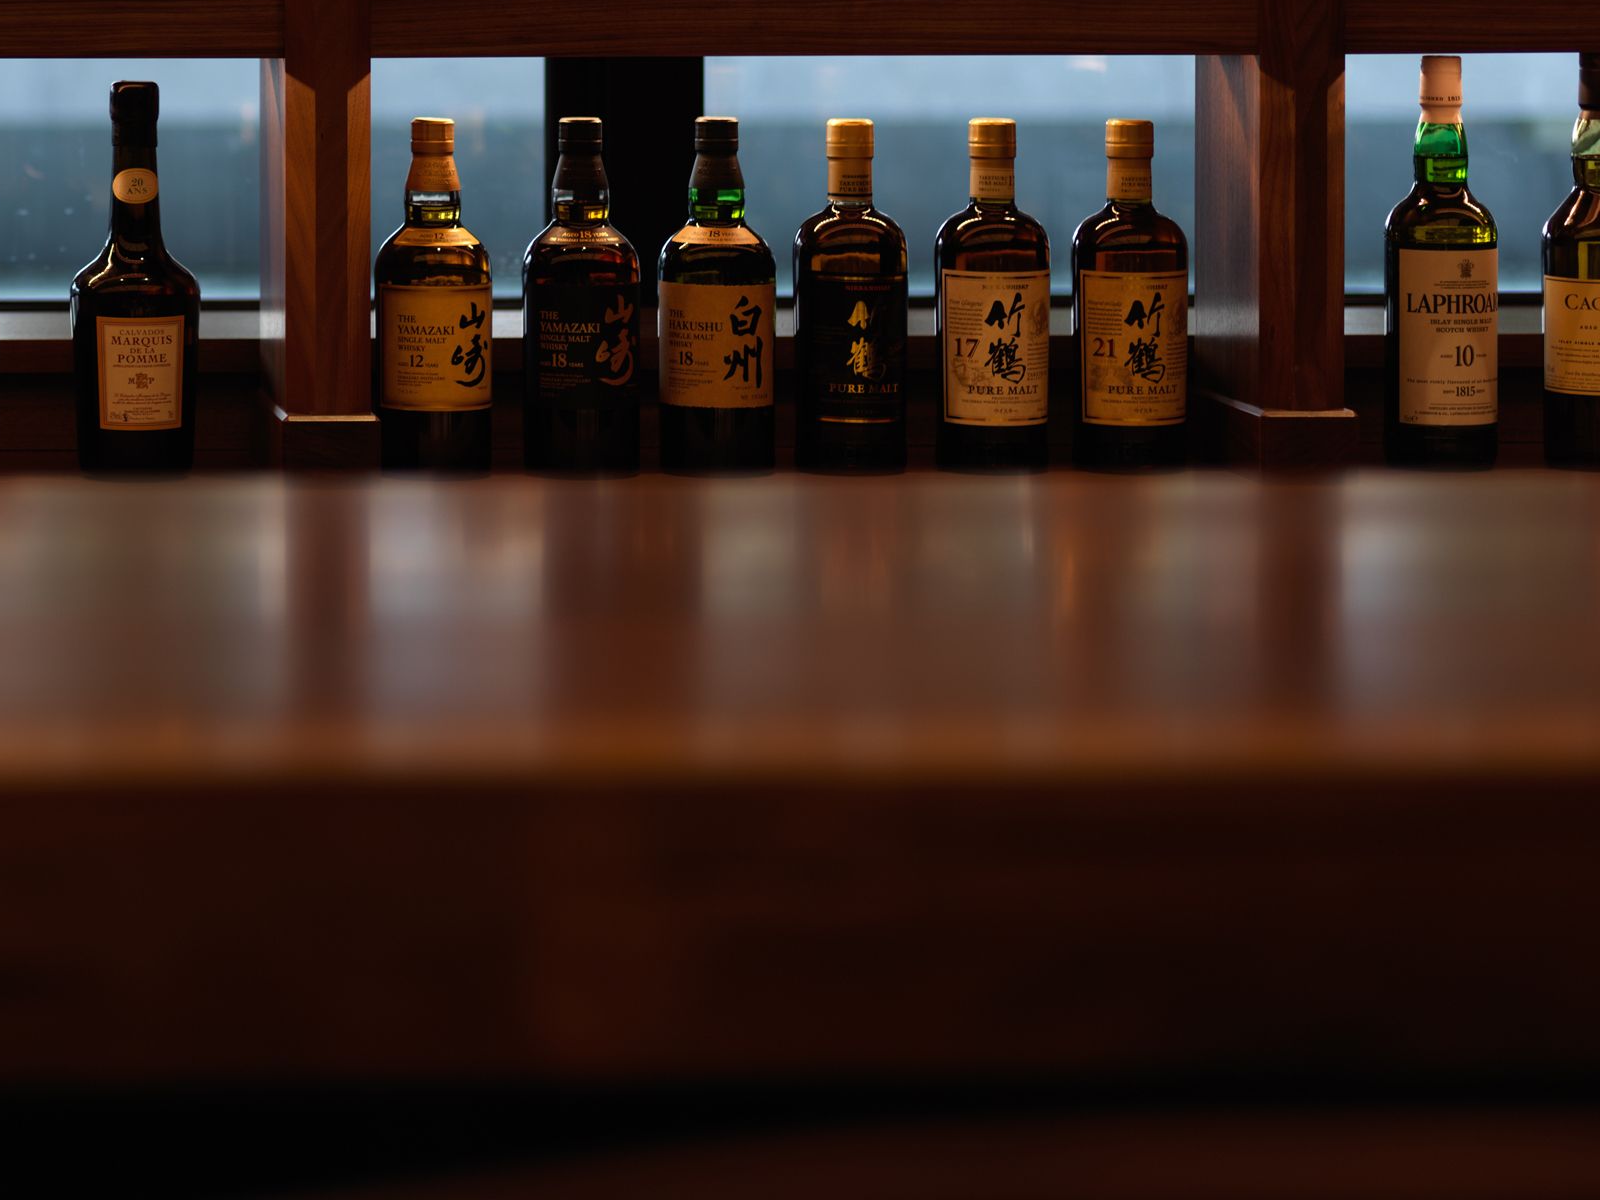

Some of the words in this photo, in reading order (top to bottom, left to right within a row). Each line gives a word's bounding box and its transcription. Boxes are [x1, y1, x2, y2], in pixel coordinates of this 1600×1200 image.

[130, 177, 144, 187] 20
[126, 187, 148, 195] ANS
[579, 231, 592, 239] 18
[540, 310, 560, 321] THE
[669, 308, 685, 319] THE
[397, 315, 416, 324] THE
[397, 325, 456, 336] YAMAZAKI
[539, 322, 601, 334] YAMAZAKI
[669, 319, 724, 333] HAKUSHU
[1436, 326, 1464, 334] SCOTCH
[119, 328, 165, 336] CALVADOS
[692, 332, 715, 341] MALT
[111, 335, 173, 348] MARQUIS
[397, 336, 423, 344] SINGLE
[539, 334, 566, 343] SINGLE
[567, 335, 592, 343] MALT
[397, 344, 426, 352] WHISKY
[539, 342, 570, 351] WHISKY
[953, 337, 981, 358] 17
[1091, 337, 1118, 357] 21
[117, 353, 168, 365] POMME
[408, 354, 424, 368] 12
[551, 352, 567, 368] 18
[678, 351, 694, 367] 18
[1454, 344, 1475, 367] 10
[829, 383, 866, 394] PURE
[967, 385, 1005, 396] PURE
[1007, 383, 1039, 396] MALT
[1107, 384, 1144, 396] PURE
[1147, 383, 1178, 395] MALT
[1455, 385, 1476, 397] 1815
